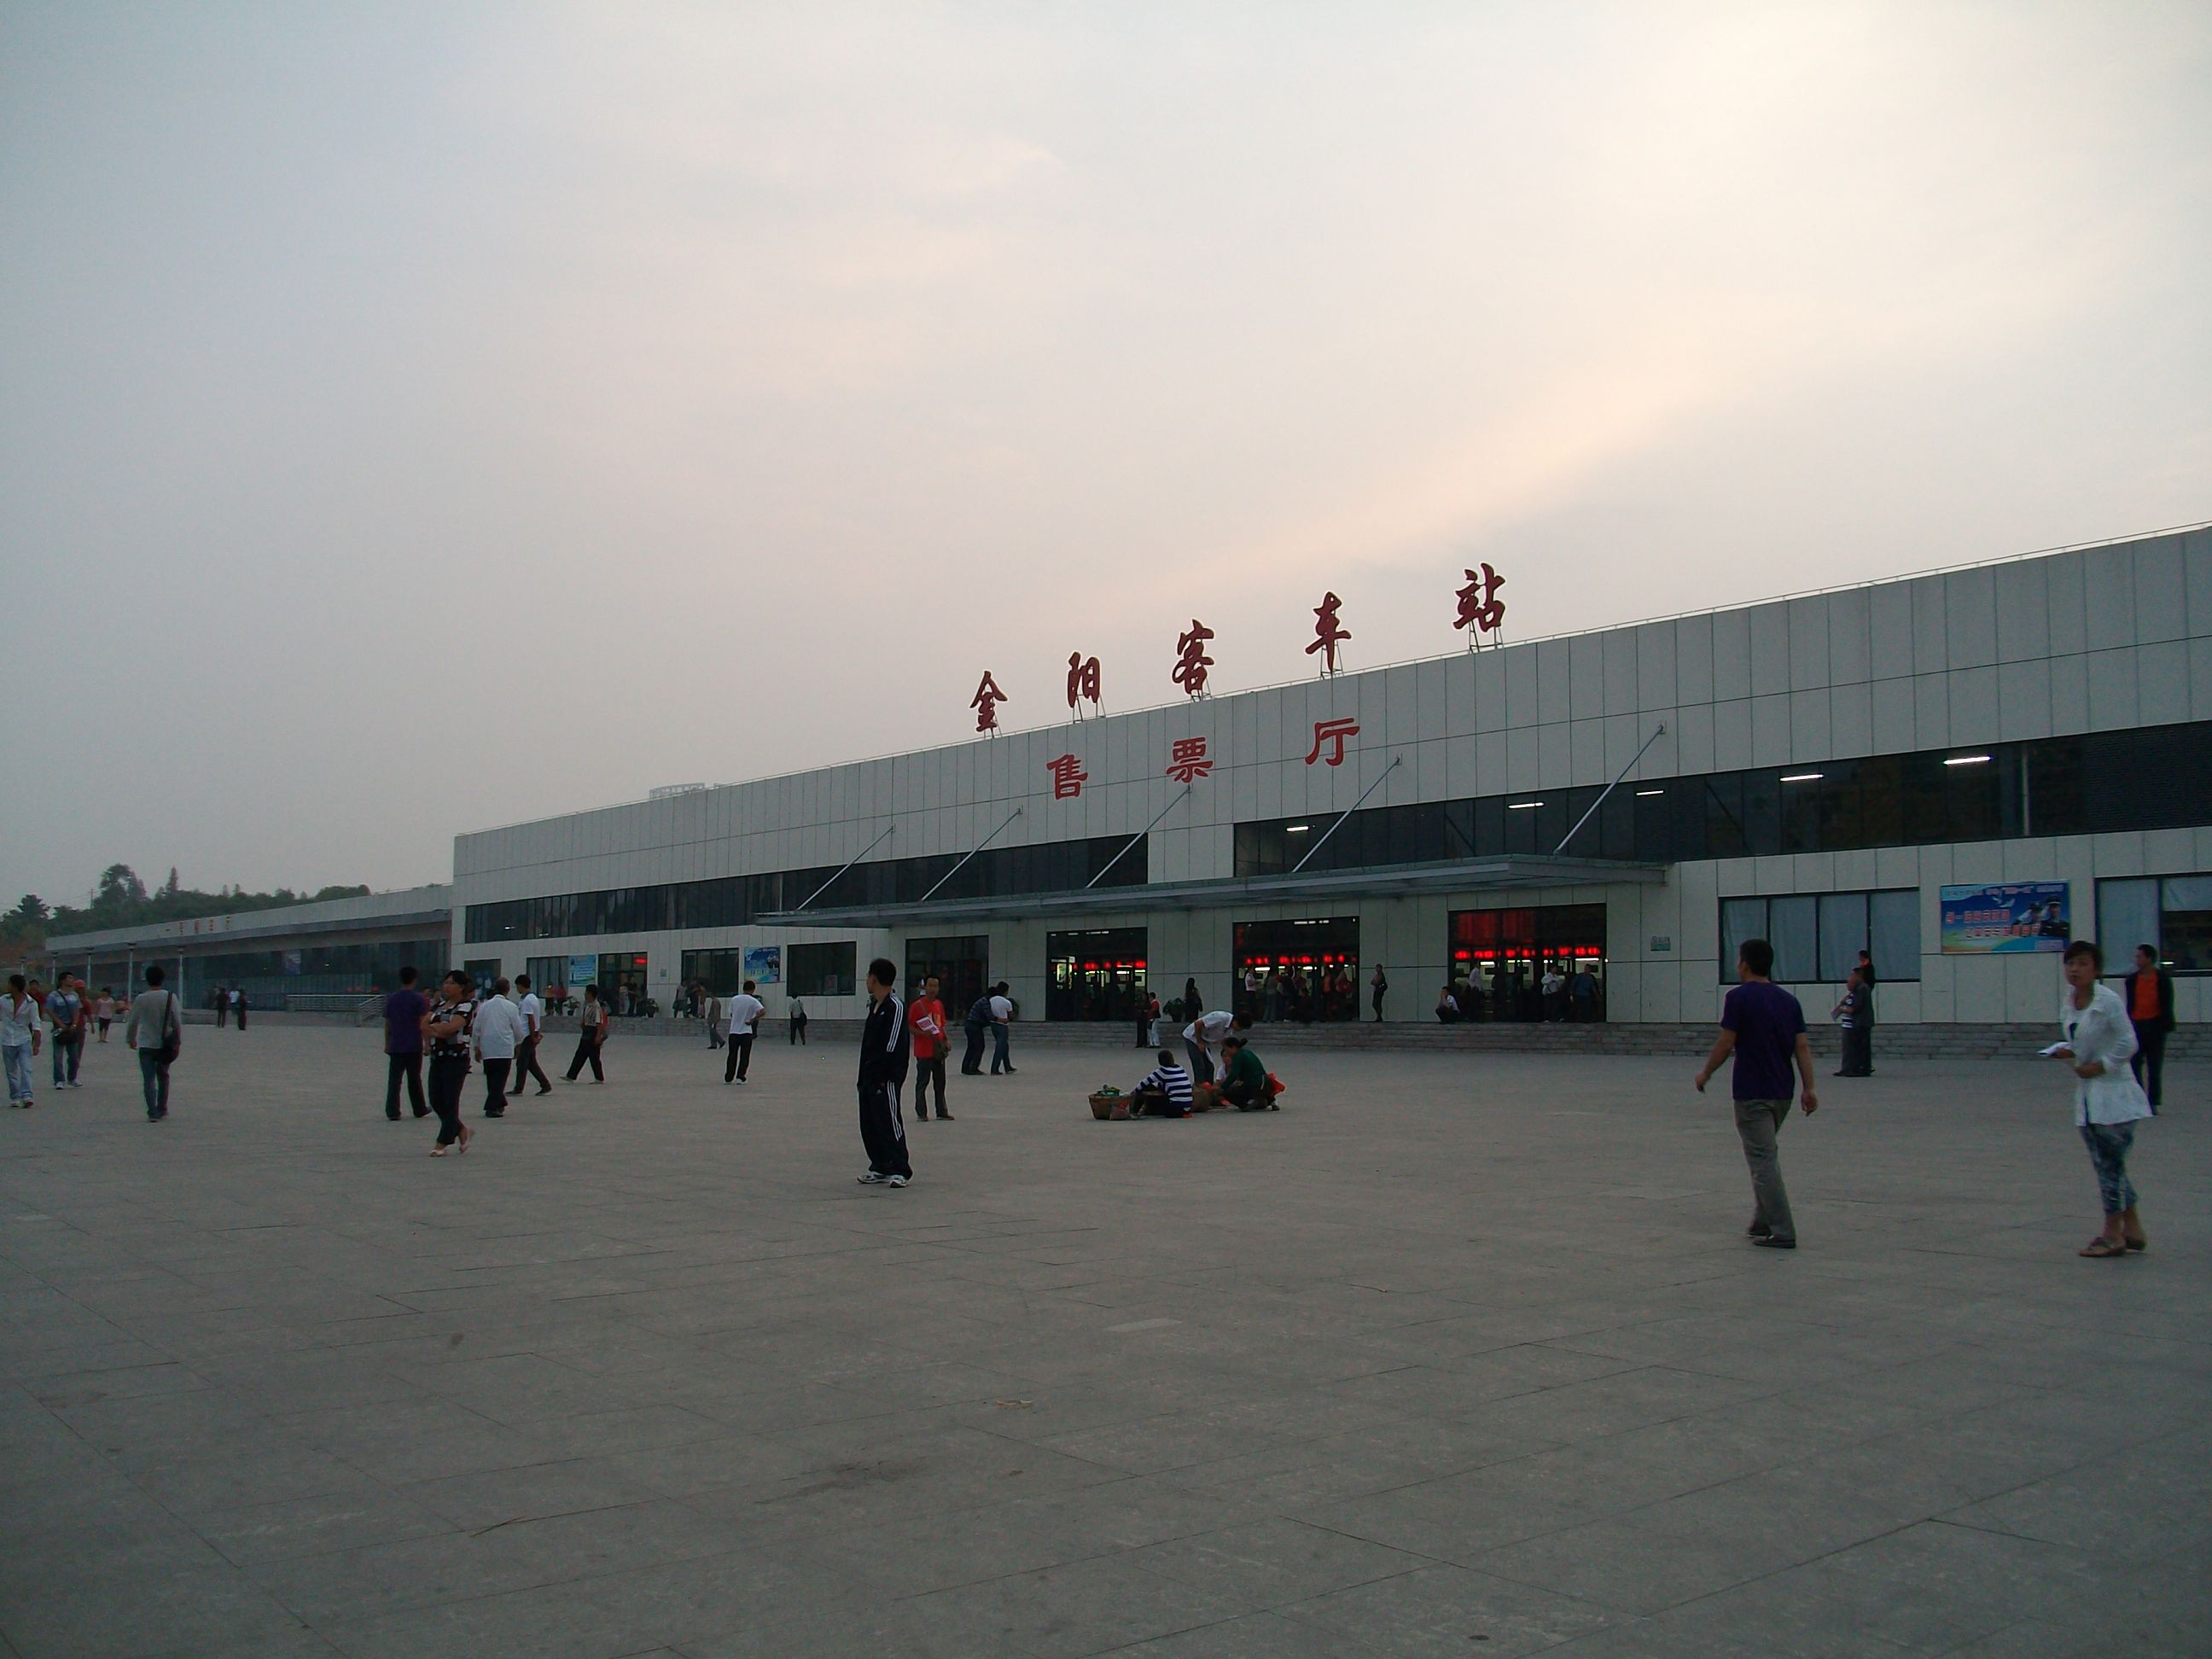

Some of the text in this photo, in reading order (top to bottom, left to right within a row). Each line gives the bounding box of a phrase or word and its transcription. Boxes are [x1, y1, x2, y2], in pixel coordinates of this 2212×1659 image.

[970, 562, 1505, 732] 金阳客车站
[1046, 718, 1360, 800] 售票厅
